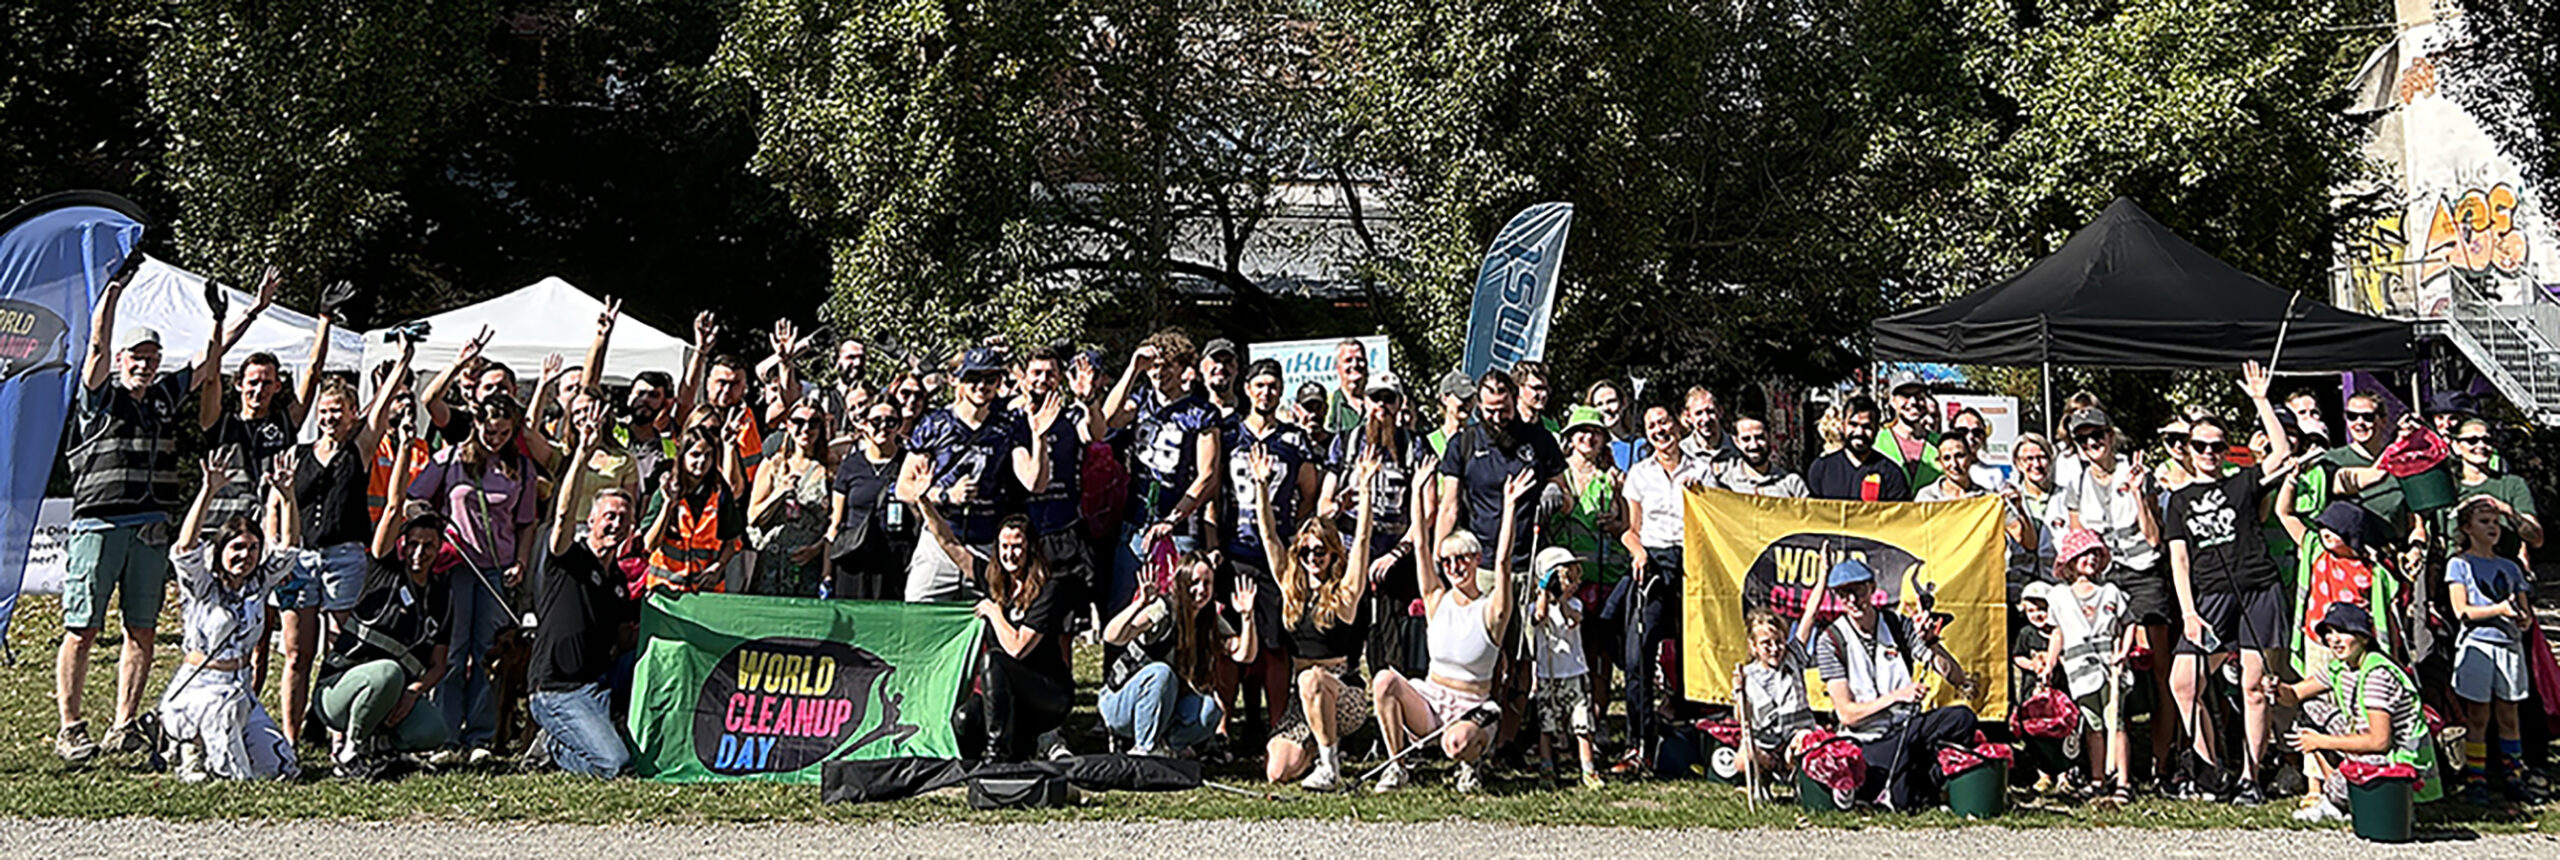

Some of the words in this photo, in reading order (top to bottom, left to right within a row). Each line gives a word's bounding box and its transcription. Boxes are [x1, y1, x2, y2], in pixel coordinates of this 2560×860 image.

[0, 308, 36, 336] ORLD
[0, 333, 39, 359] ANUP
[1770, 585, 1888, 619] CLEANP
[738, 649, 836, 696] WORLD
[725, 692, 853, 738] CLEANUP
[714, 733, 776, 770] DAY
